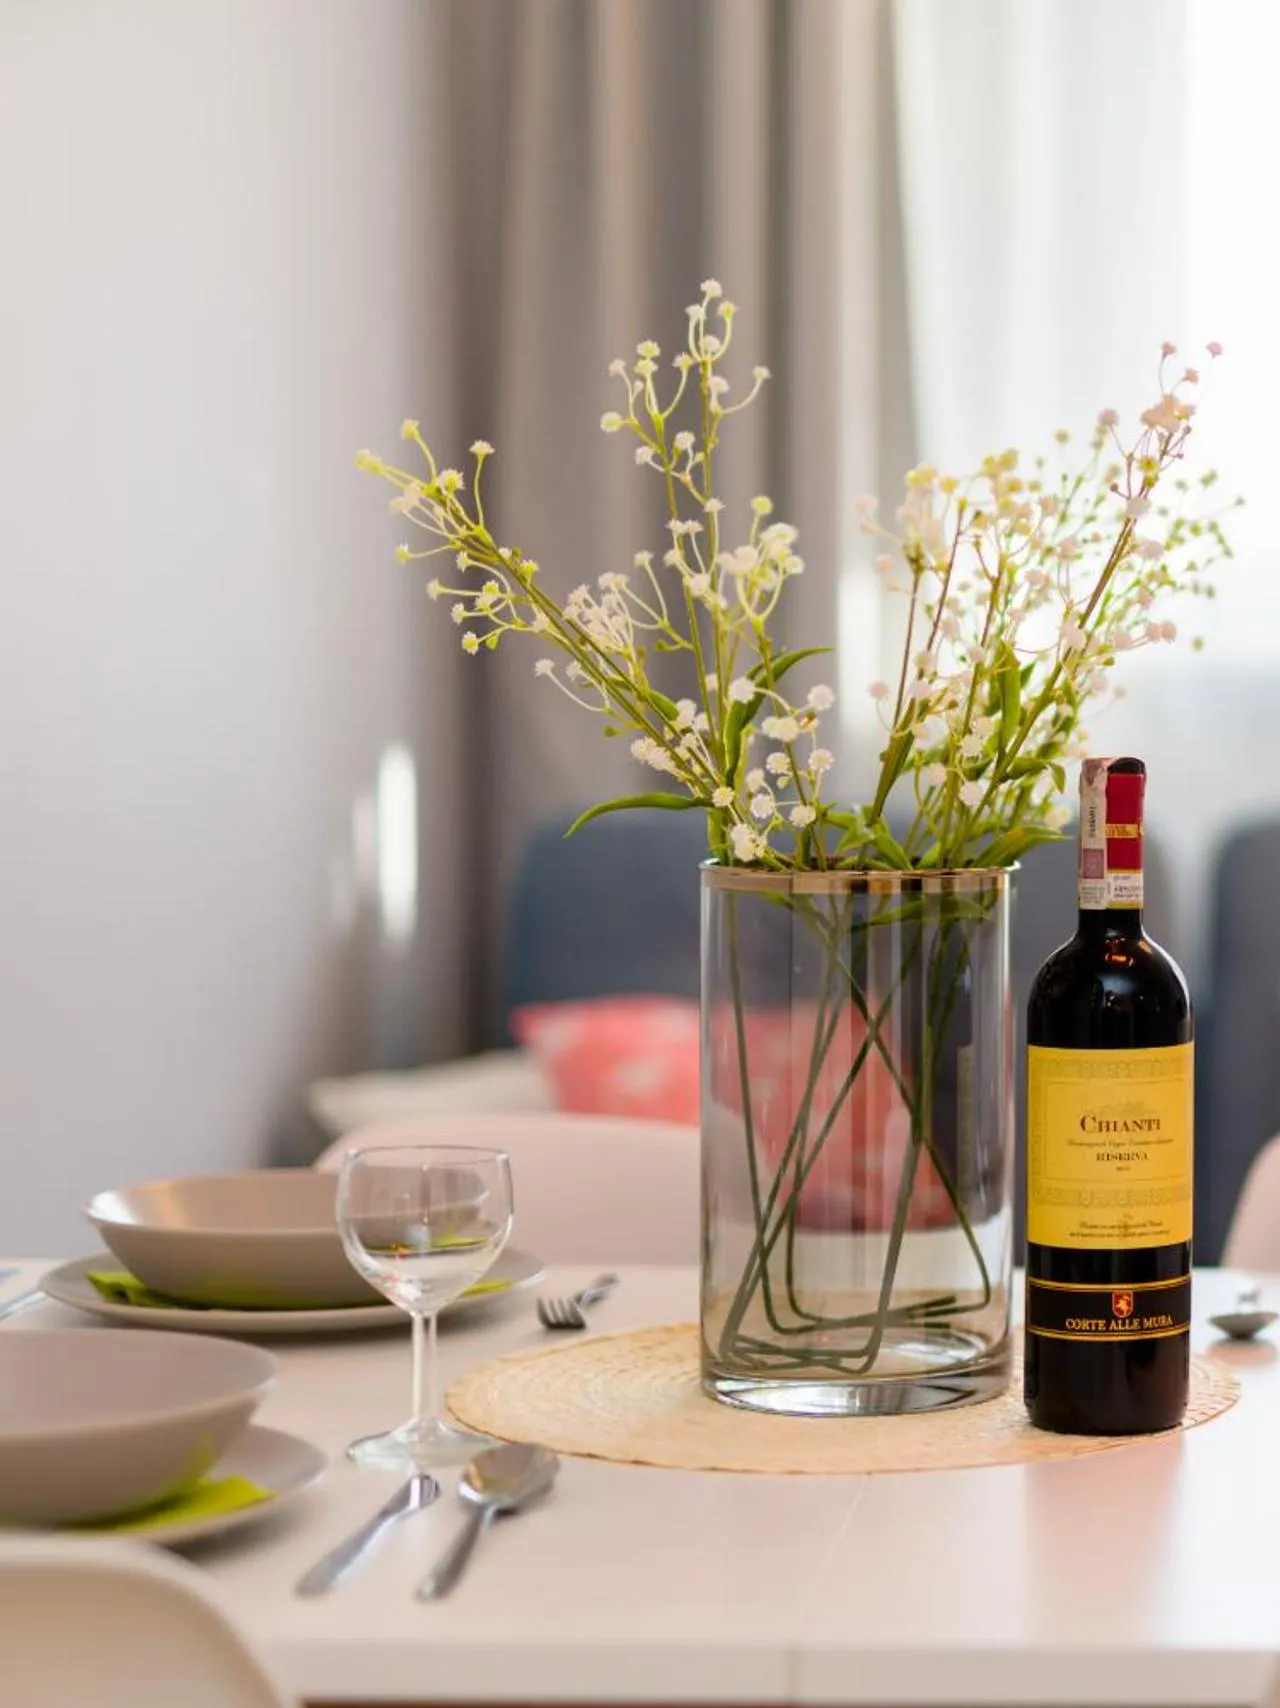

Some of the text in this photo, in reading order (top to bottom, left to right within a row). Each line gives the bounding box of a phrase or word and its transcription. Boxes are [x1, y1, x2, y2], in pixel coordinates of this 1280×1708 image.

[1080, 1114, 1161, 1133] CHIANTI
[1096, 1152, 1149, 1161] RISERVA
[1065, 1318, 1106, 1330] CORTE
[1109, 1318, 1141, 1330] ALLE
